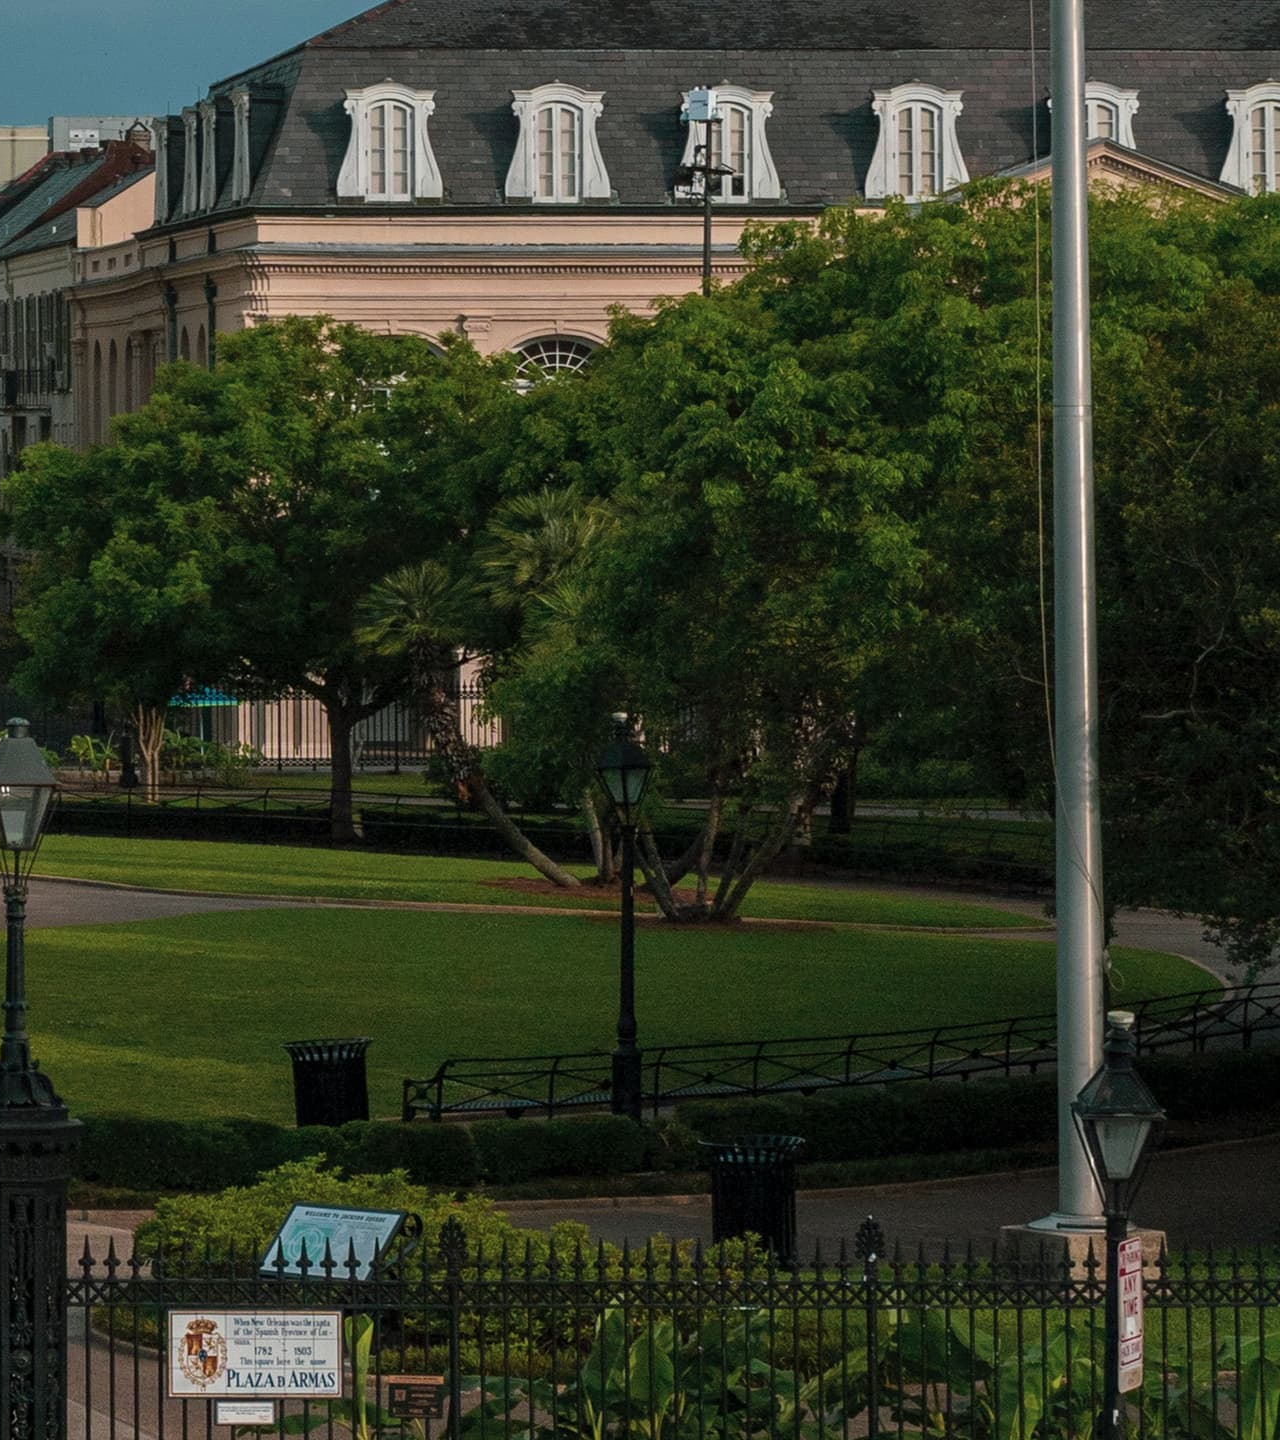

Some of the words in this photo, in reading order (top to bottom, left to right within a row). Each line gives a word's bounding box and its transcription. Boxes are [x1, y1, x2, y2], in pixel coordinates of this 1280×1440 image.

[1124, 1274, 1137, 1296] ANY
[1123, 1297, 1138, 1317] TIME
[233, 1318, 250, 1327] When
[251, 1318, 265, 1327] New
[267, 1318, 289, 1327] Orleans
[302, 1318, 312, 1327] the
[234, 1328, 241, 1336] of
[243, 1328, 253, 1336] the
[255, 1328, 279, 1338] Spanish
[281, 1328, 307, 1337] Province
[310, 1328, 317, 1336] of
[294, 1347, 312, 1356] 1803
[240, 1357, 253, 1365] This
[255, 1359, 274, 1368] square
[295, 1357, 305, 1365] the
[227, 1369, 275, 1388] PLAZA
[287, 1370, 336, 1388] ARMAS
